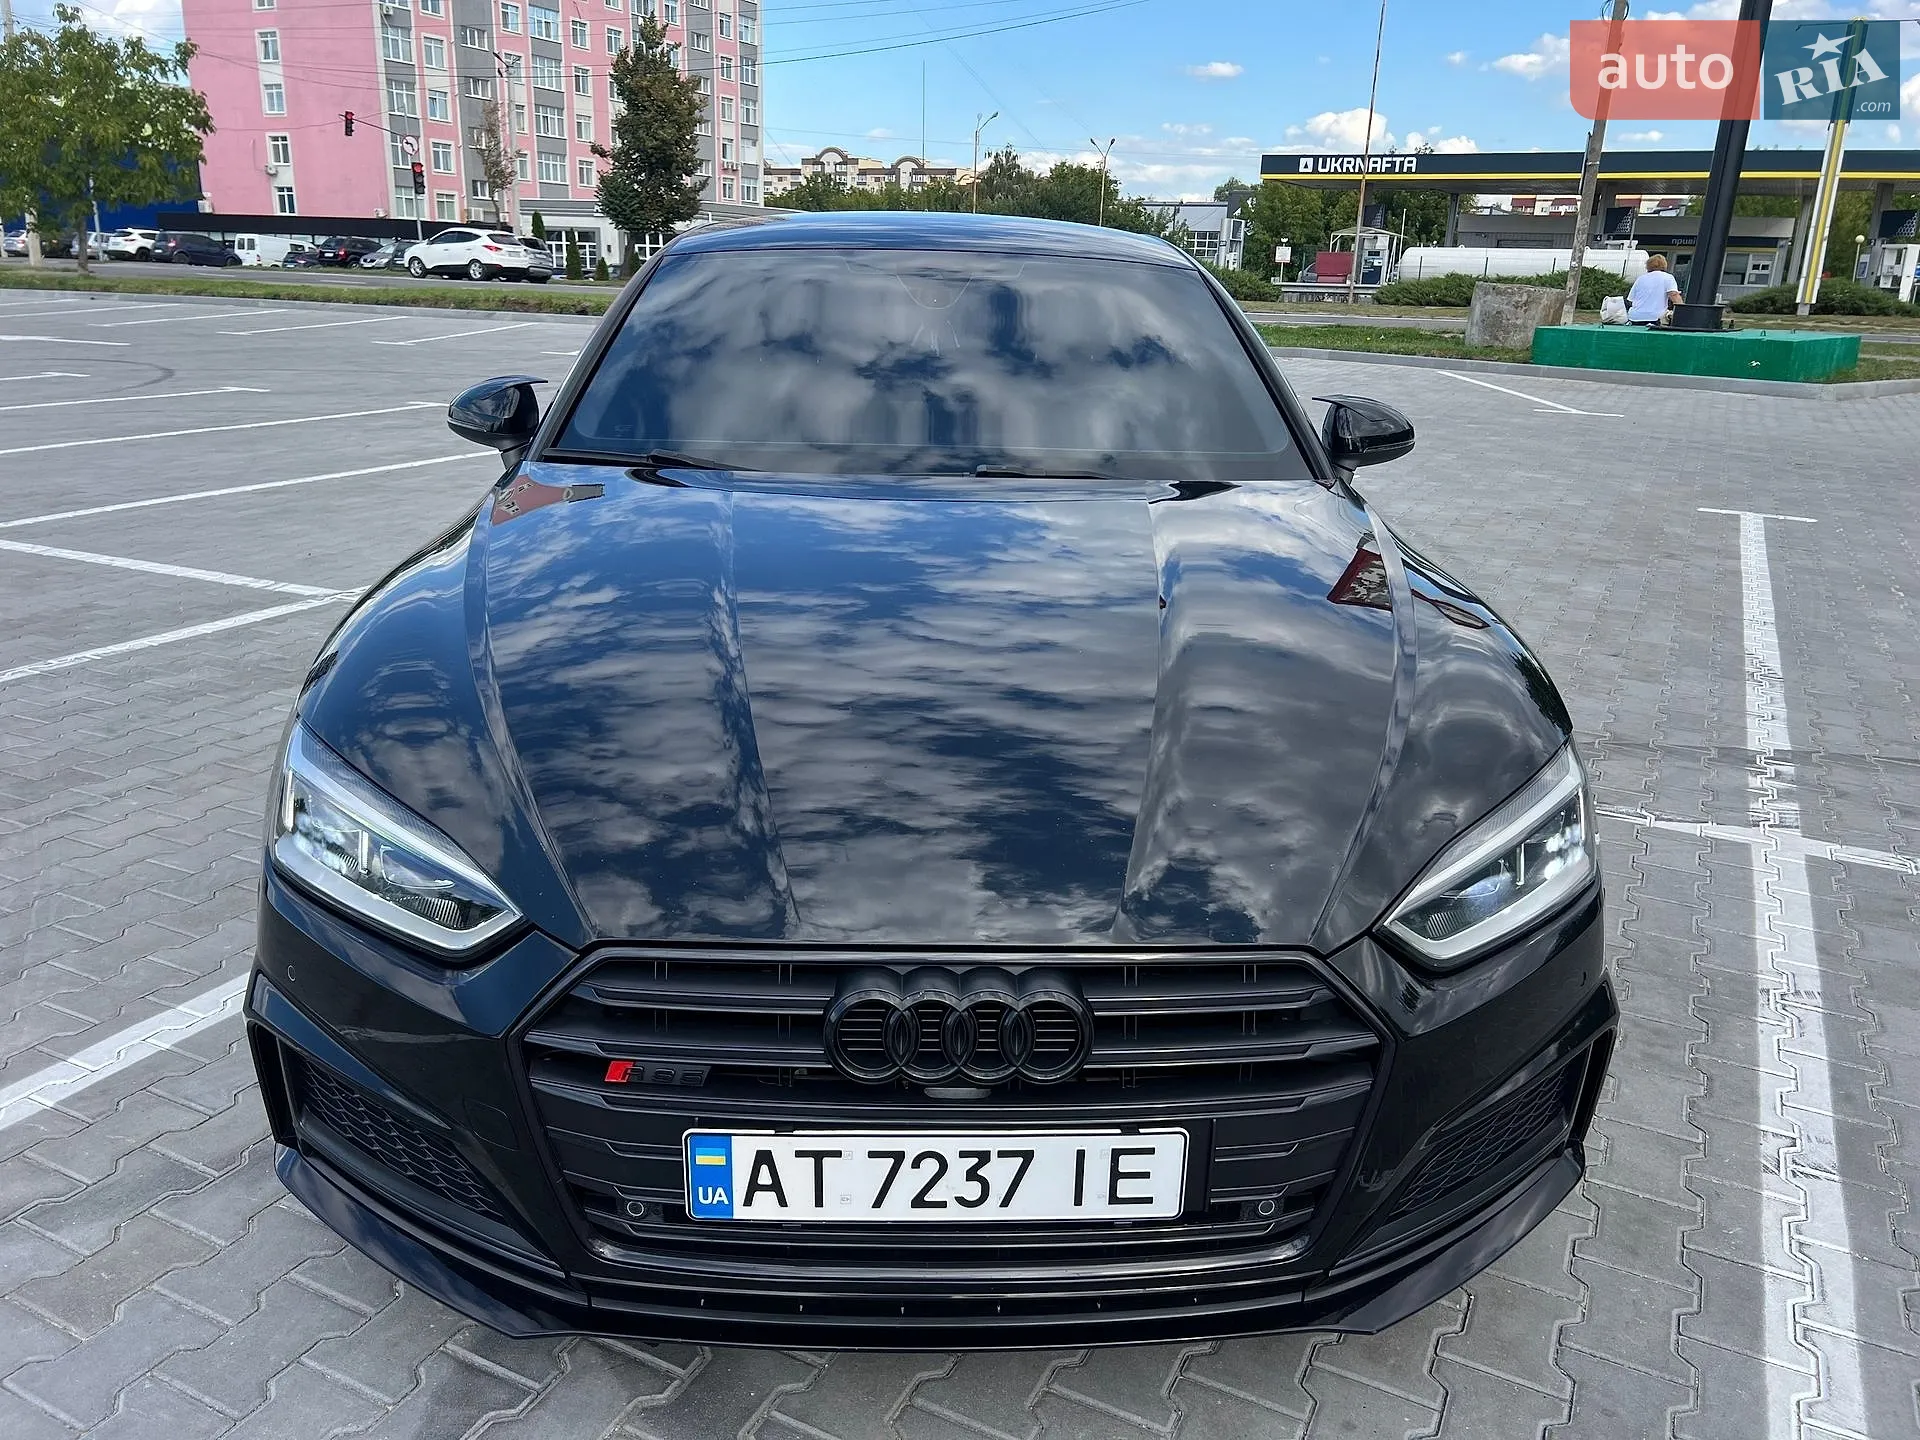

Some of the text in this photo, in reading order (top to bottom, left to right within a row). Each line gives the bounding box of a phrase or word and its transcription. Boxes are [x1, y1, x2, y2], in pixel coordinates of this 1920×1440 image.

[1317, 156, 1417, 173] UKRNAFTA
[743, 1147, 1156, 1209] AT 7237 IE
[698, 1187, 729, 1205] UA
